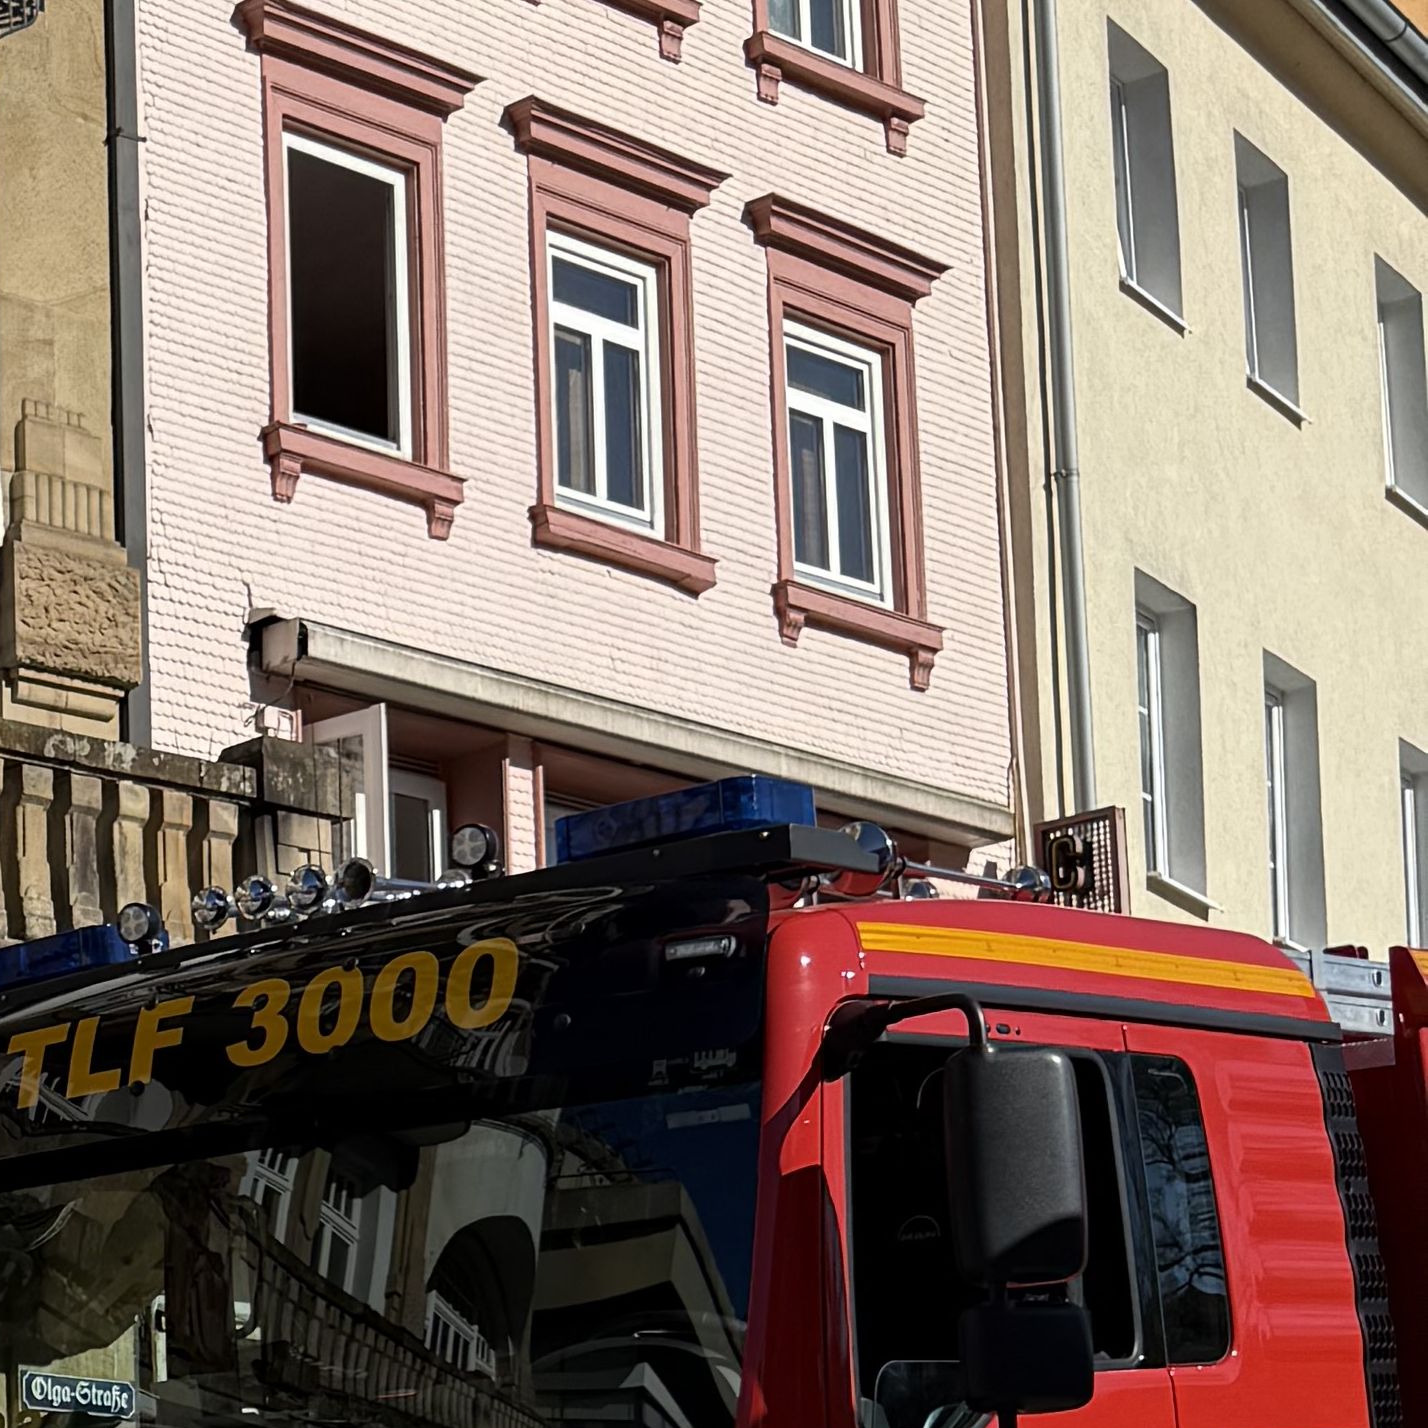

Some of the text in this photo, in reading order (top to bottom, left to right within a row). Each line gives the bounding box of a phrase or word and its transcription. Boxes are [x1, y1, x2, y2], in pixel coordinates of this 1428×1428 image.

[6, 937, 520, 1109] TLF 3000
[31, 1376, 129, 1413] Olga-Straße
